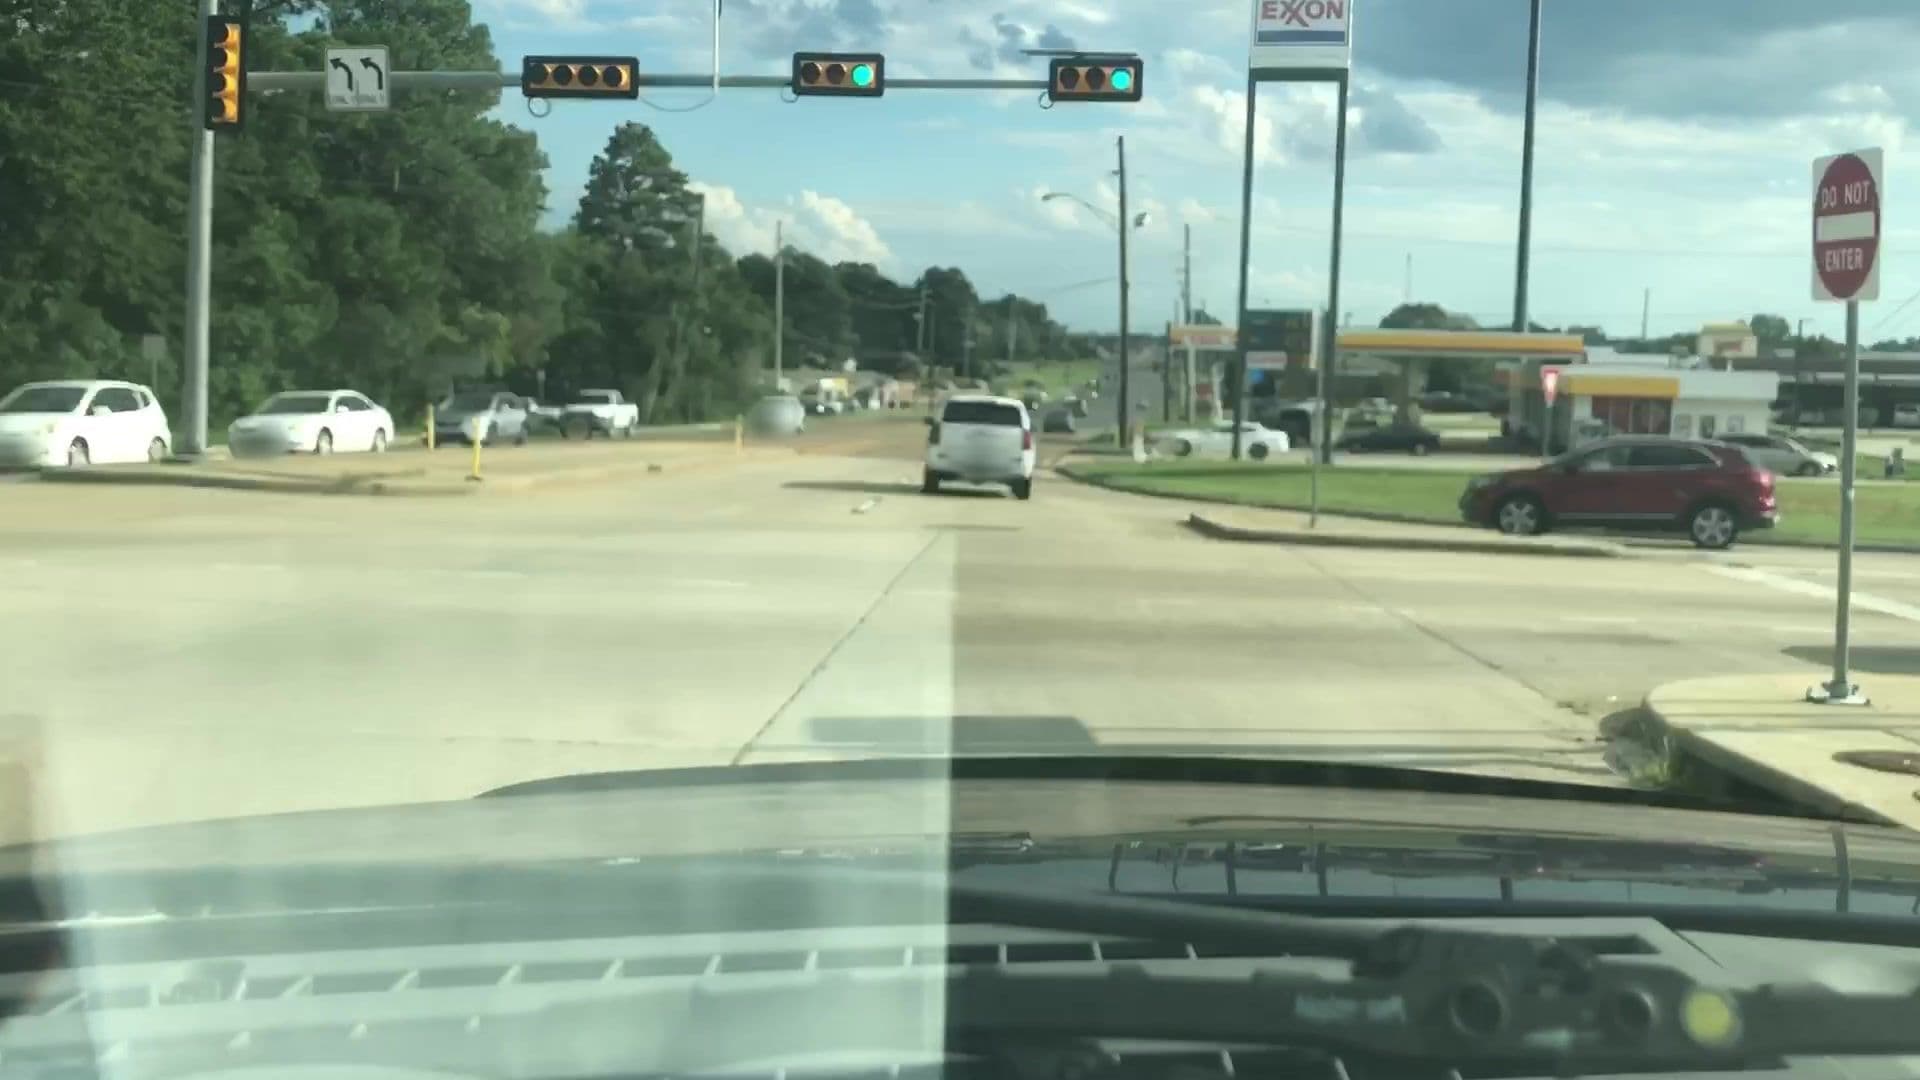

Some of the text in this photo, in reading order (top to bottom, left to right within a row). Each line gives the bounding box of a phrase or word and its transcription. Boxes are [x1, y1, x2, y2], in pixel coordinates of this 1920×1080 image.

[1261, 0, 1344, 27] EXXON
[1821, 180, 1870, 209] DO NOT
[1825, 247, 1863, 273] ENTER
